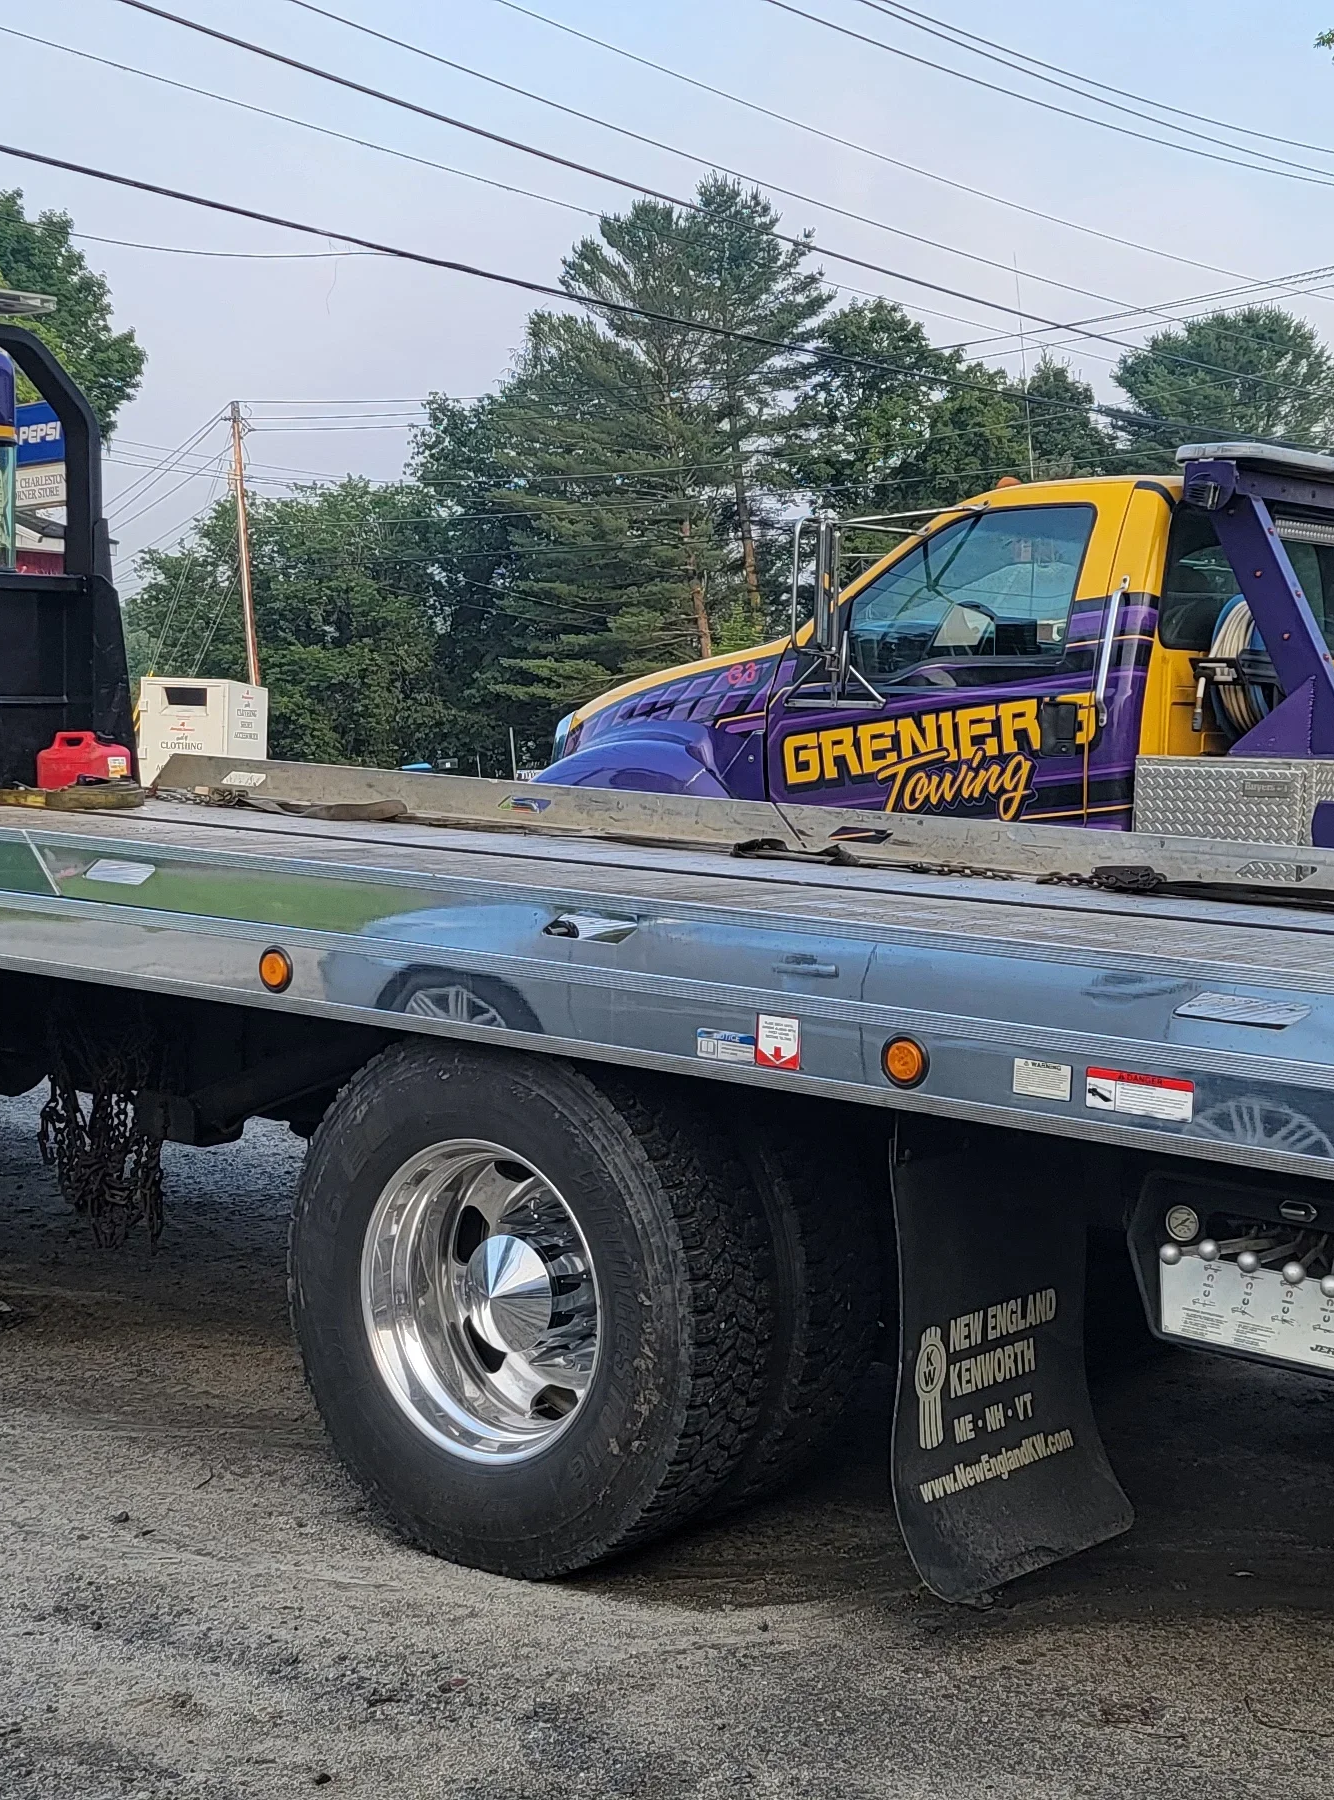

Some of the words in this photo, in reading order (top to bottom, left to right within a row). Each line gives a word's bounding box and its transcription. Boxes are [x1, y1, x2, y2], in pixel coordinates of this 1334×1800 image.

[19, 421, 61, 445] PEPSI
[41, 486, 60, 498] STORE
[728, 662, 756, 685] G3
[161, 741, 203, 750] CLOTHING
[783, 691, 1097, 785] GRENIERS
[877, 749, 1034, 821] Towing
[714, 1032, 741, 1043] NOTICE
[1031, 1061, 1062, 1071] WARNING
[1126, 1073, 1164, 1086] DANGER
[949, 1309, 984, 1353] NEW
[987, 1288, 1057, 1340] ENGLAND
[949, 1337, 1036, 1399] KENWORTH
[954, 1414, 976, 1444] ME
[984, 1402, 1006, 1433] NH
[1015, 1392, 1033, 1421] VT
[919, 1428, 1075, 1504] www.NewEnglandKW.com
